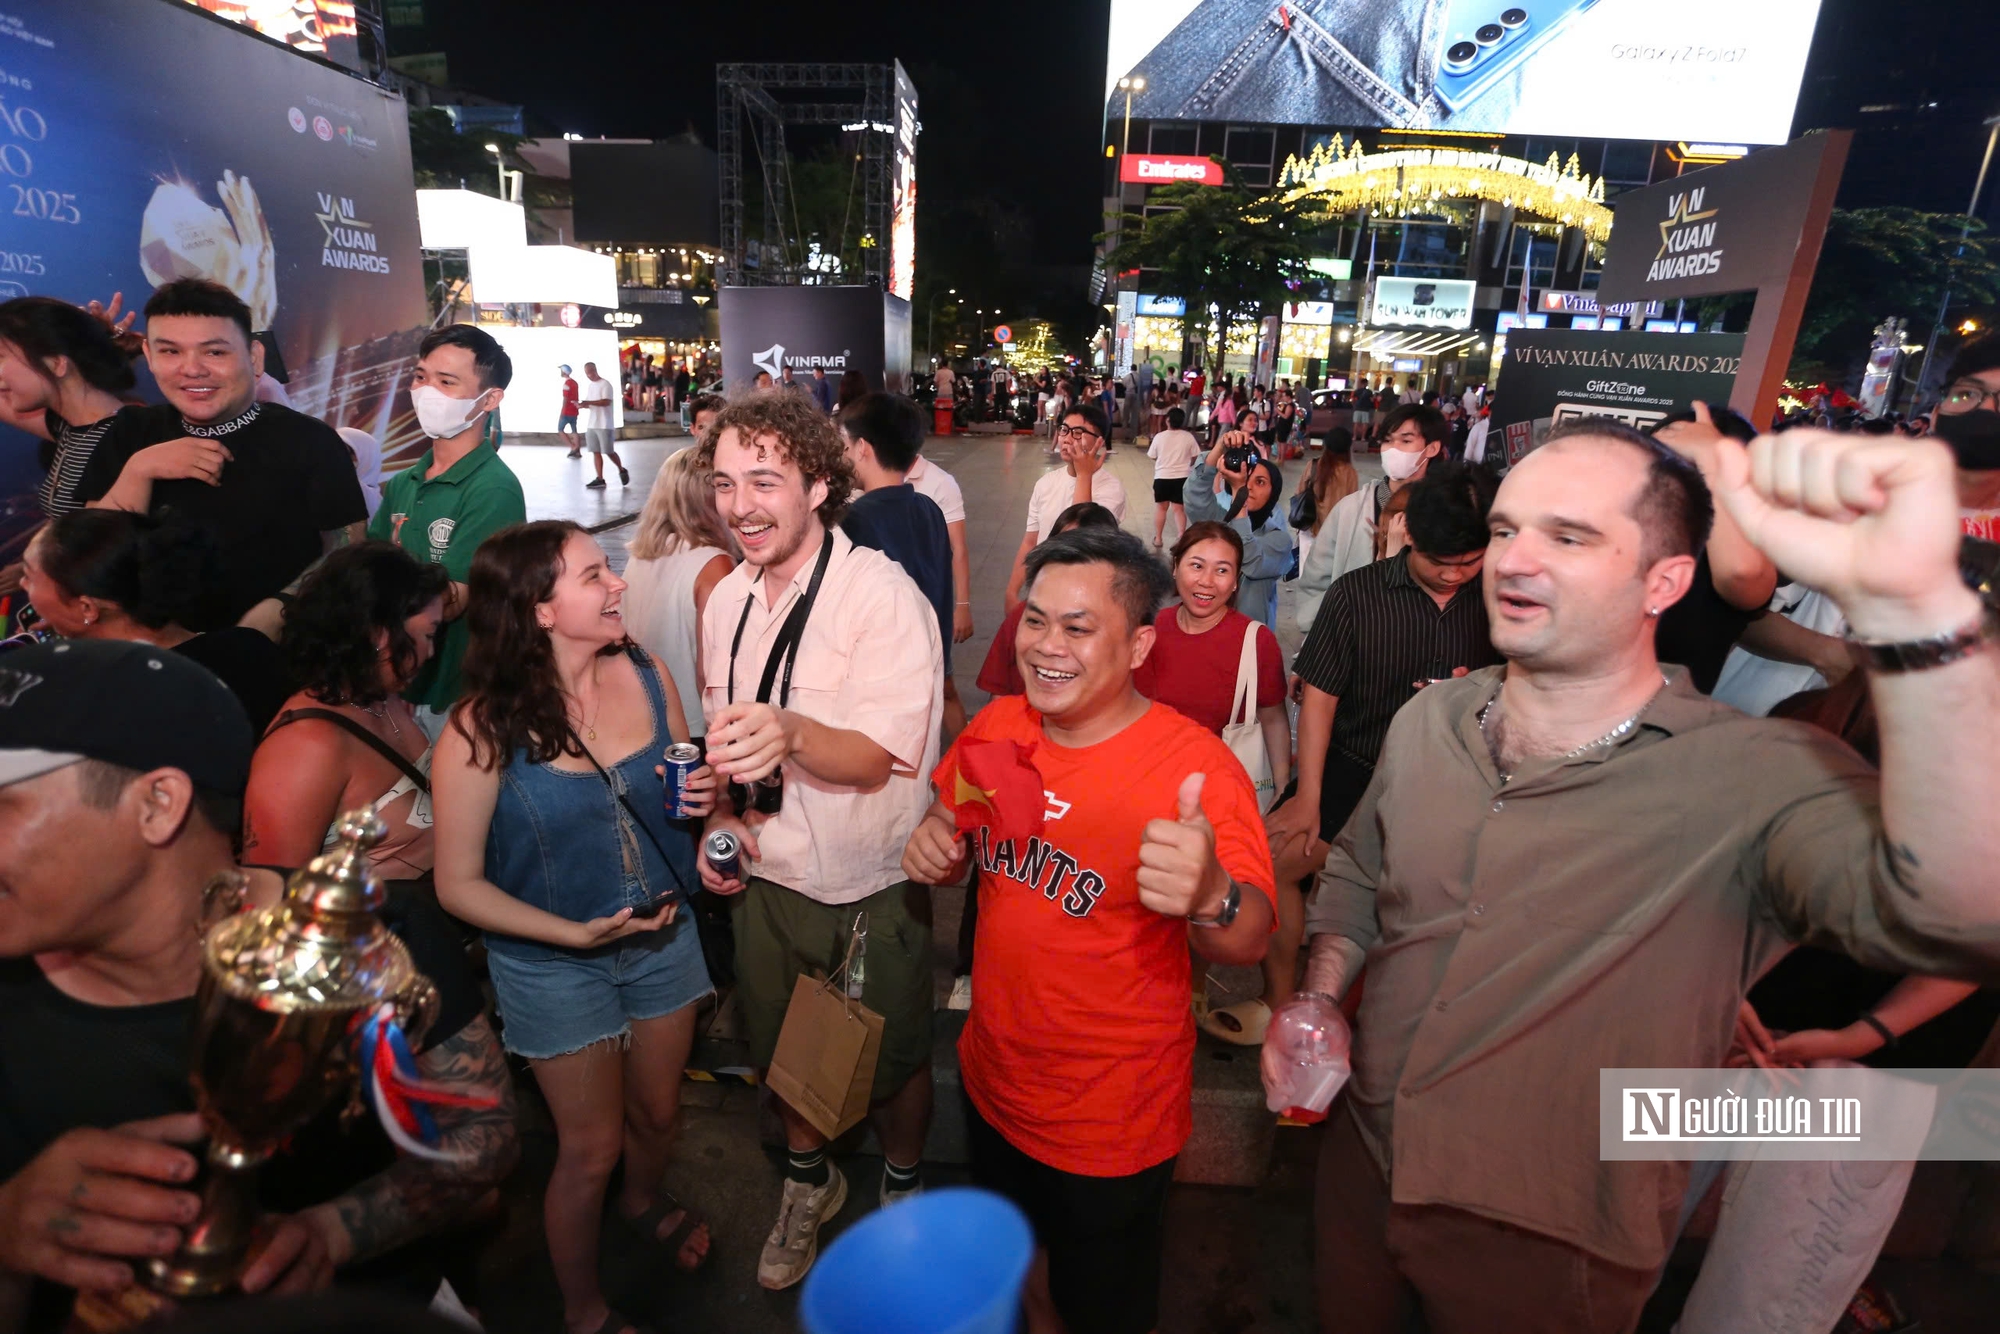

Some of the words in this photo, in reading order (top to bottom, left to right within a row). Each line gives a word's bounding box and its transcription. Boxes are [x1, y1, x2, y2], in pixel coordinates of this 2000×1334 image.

[1611, 43, 1679, 65] Galaxy
[1681, 46, 1693, 61] Z
[1138, 160, 1206, 179] Emirates
[9, 184, 81, 224] 2025
[321, 248, 390, 275] AWARDS
[1646, 249, 1724, 282] AWARDS
[1429, 307, 1467, 320] TOWER
[784, 355, 846, 367] VINAMA
[1515, 345, 1534, 363] VÍ
[1534, 349, 1568, 368] VẠN
[1568, 348, 1625, 368] XUÂN
[1624, 353, 1709, 374] AWARDS
[1710, 356, 1741, 375] 202
[972, 824, 1107, 918] IANTS
